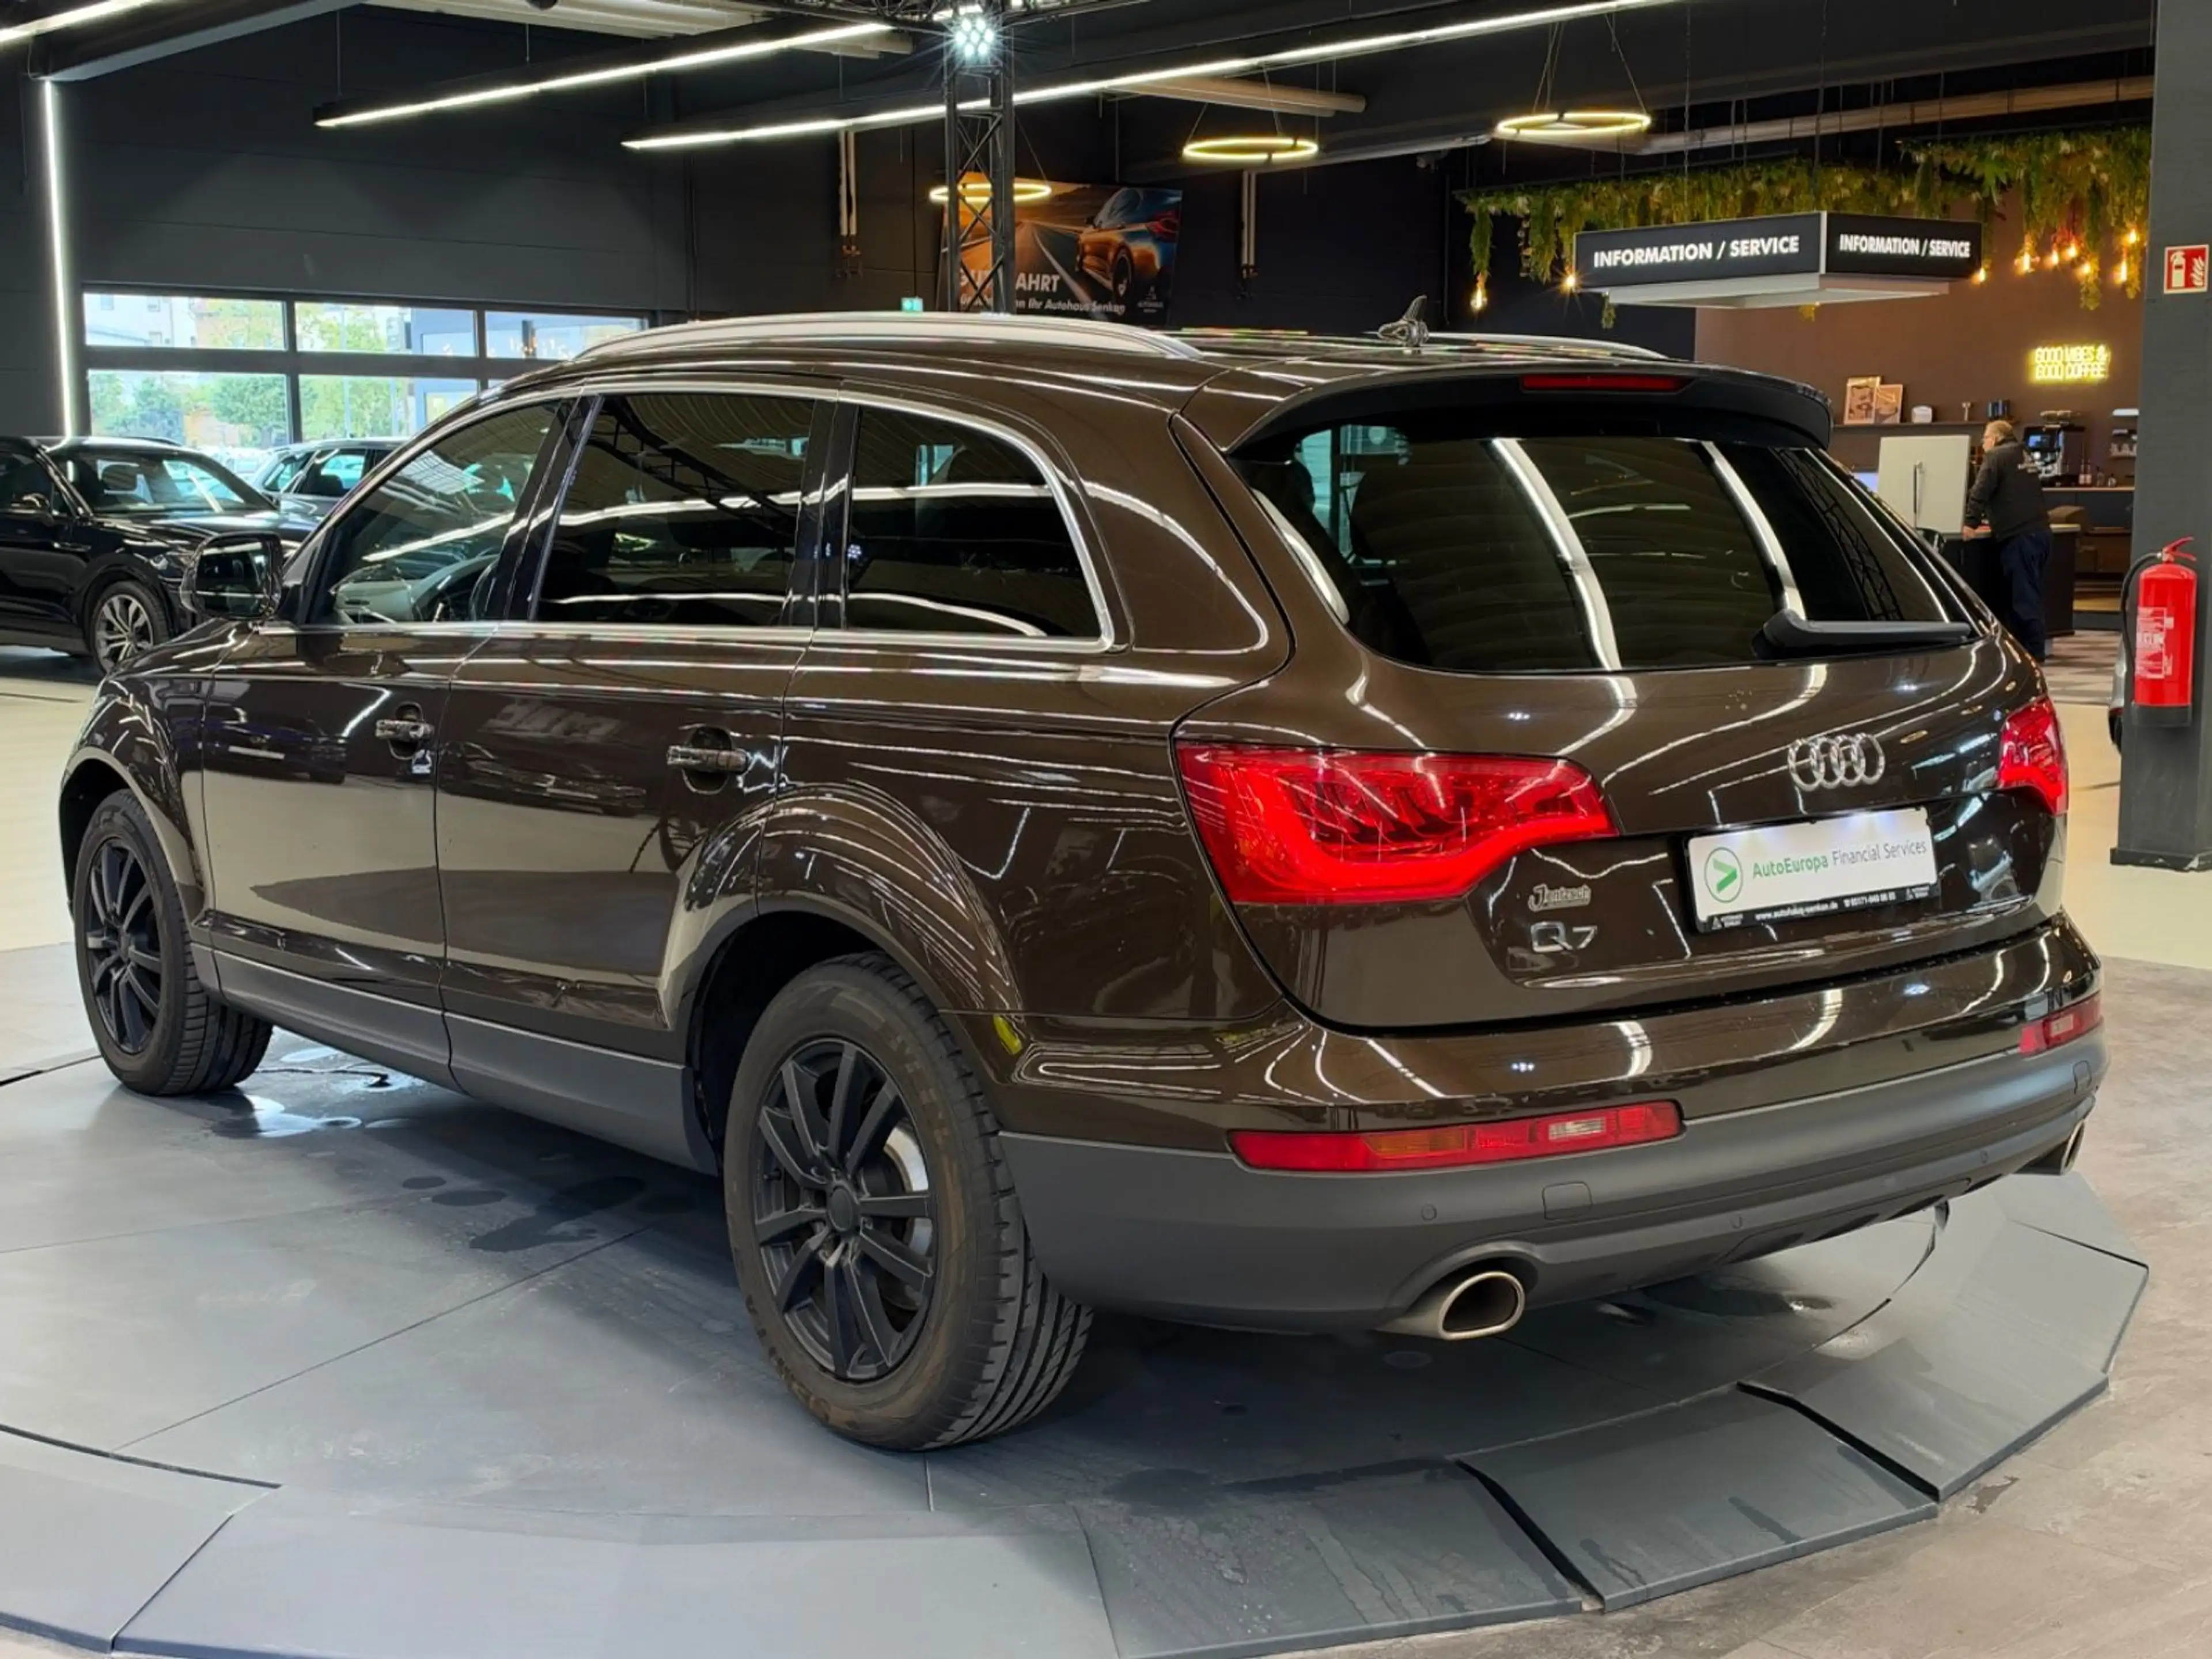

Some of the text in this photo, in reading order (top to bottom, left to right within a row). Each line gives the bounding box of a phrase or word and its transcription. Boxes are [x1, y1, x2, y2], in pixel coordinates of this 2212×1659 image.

[1593, 234, 1800, 268] INFORMATION / SERVICE
[1839, 233, 1920, 255] INFORMATION
[1929, 238, 1971, 258] SERVICE
[1015, 272, 1060, 293] AHRT
[1752, 839, 1927, 879] AutoEuropa Financial Services
[1530, 921, 1598, 953] Q7
